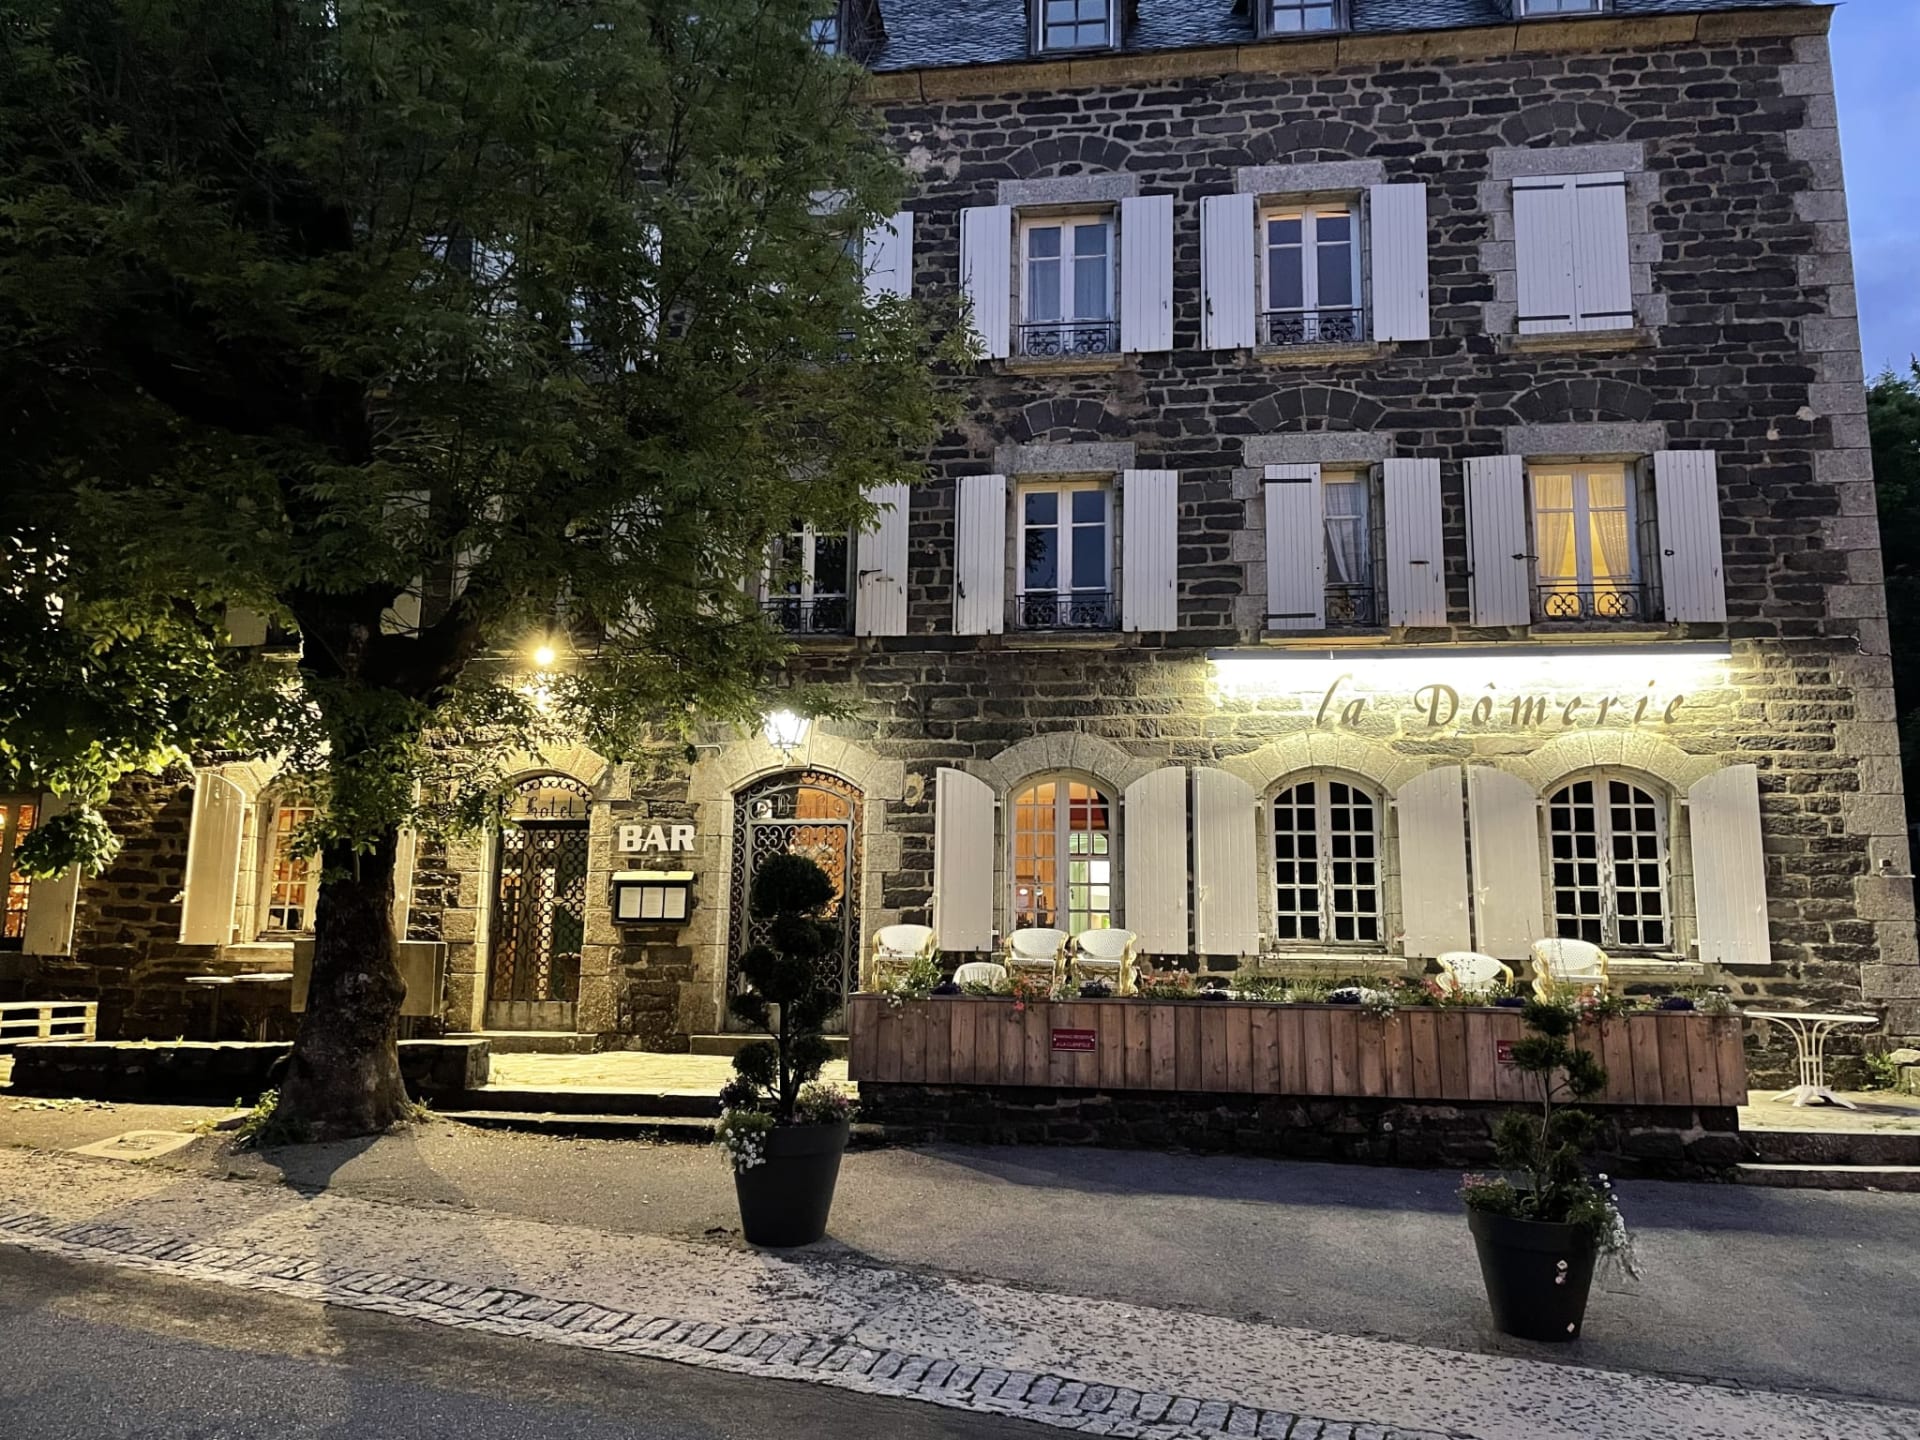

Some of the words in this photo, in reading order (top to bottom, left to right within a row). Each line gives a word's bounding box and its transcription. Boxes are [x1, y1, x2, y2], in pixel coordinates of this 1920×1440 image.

[1316, 673, 1367, 726] la
[1414, 679, 1685, 727] Dômerie
[618, 825, 695, 852] BAR
